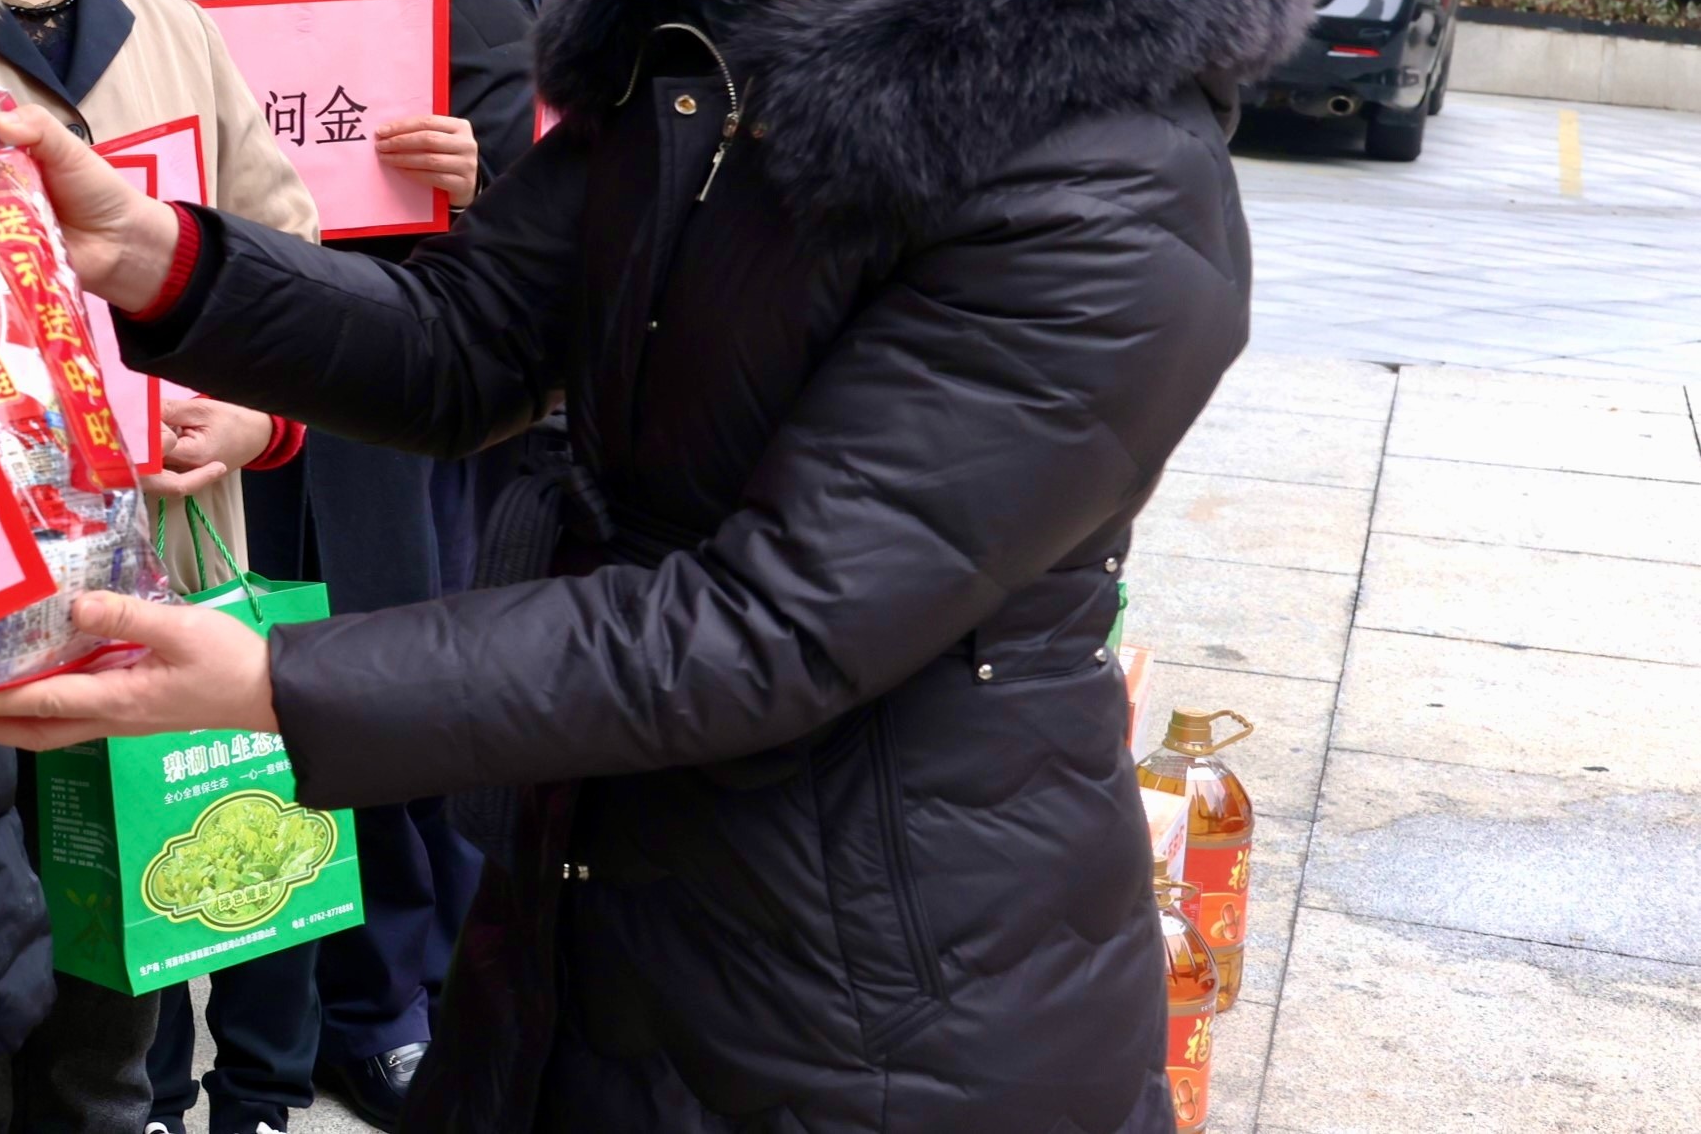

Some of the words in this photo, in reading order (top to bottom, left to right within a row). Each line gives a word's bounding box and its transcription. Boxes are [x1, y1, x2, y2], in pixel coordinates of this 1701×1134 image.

[163, 777, 229, 805] 全心全意保生态
